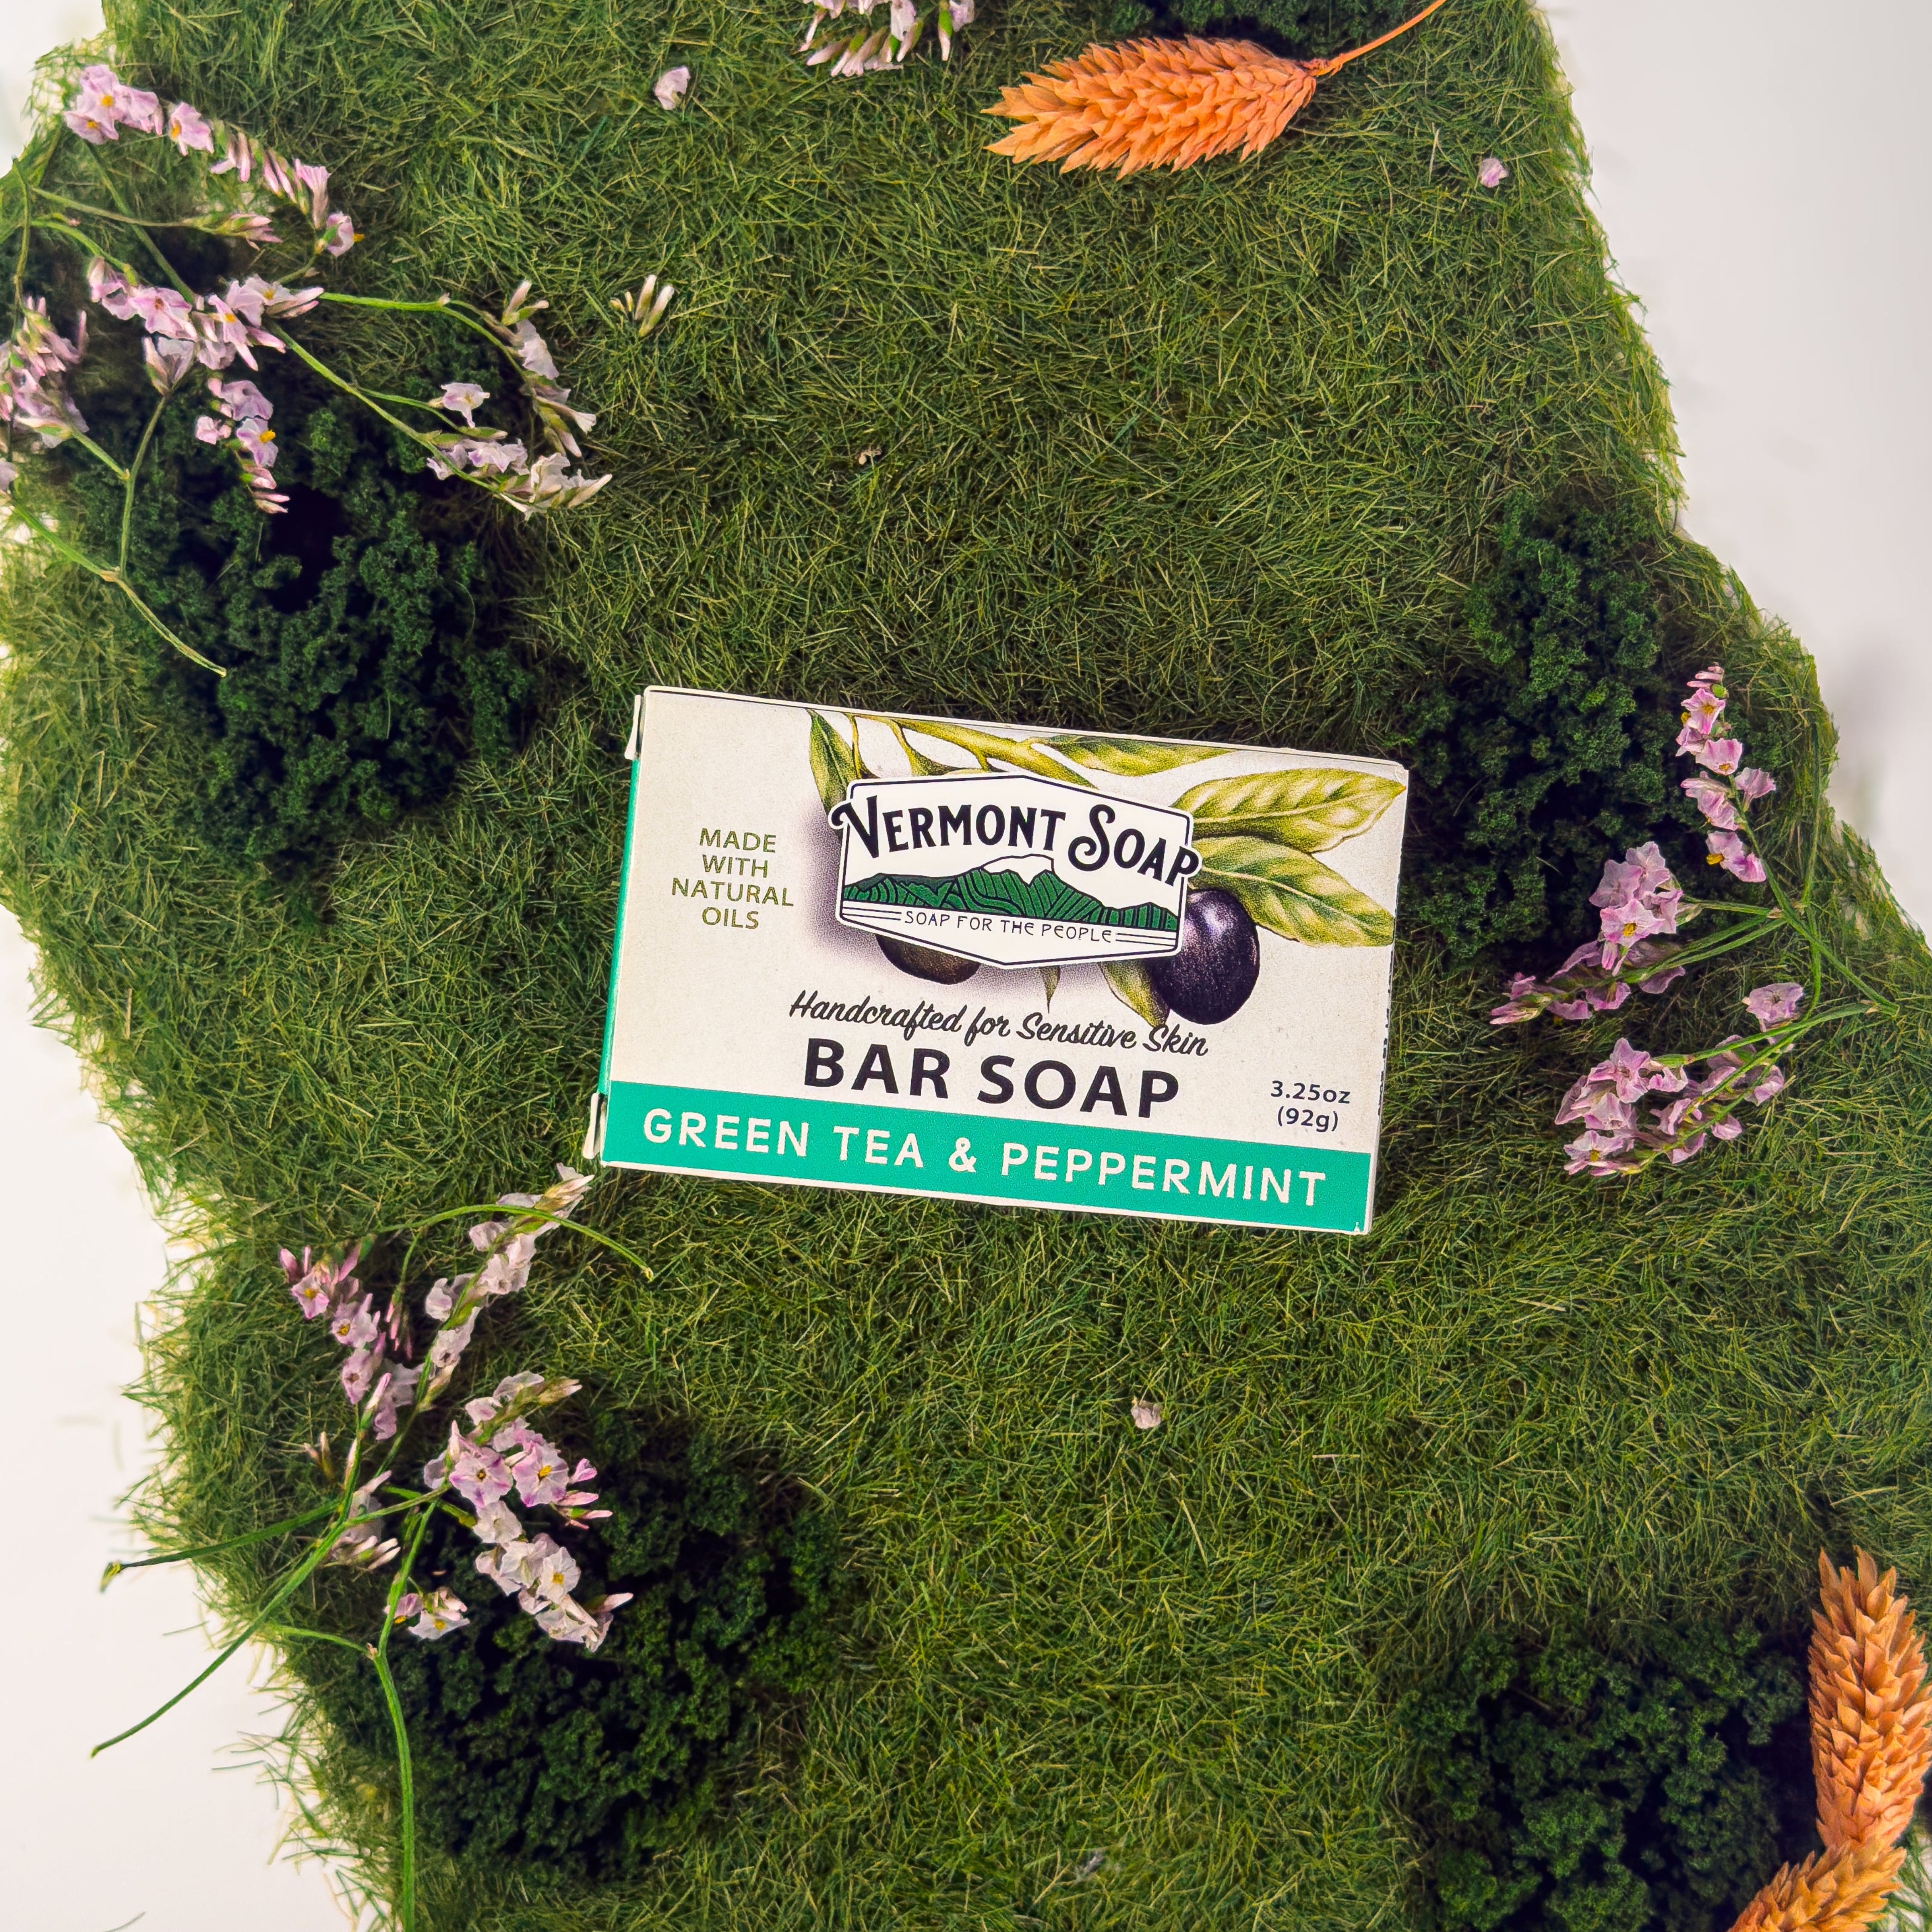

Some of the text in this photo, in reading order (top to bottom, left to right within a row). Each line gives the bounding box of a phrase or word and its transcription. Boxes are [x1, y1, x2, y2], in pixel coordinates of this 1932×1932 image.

[699, 828, 776, 853] MADE
[831, 795, 1198, 887] VERMONT SOAP
[702, 854, 769, 878] WITH
[671, 877, 794, 907] NATURAL
[701, 906, 760, 930] OILS
[904, 911, 950, 926] SOAP
[957, 916, 992, 931] FOR
[789, 990, 1209, 1057] Handcrafted for Sensitive Skin
[804, 1037, 1179, 1118] BAR SOAP
[1270, 1080, 1351, 1104] 3.25oz
[1277, 1106, 1338, 1133] (92g)
[643, 1108, 1327, 1207] GREEN TEA & PEPPERMINT
